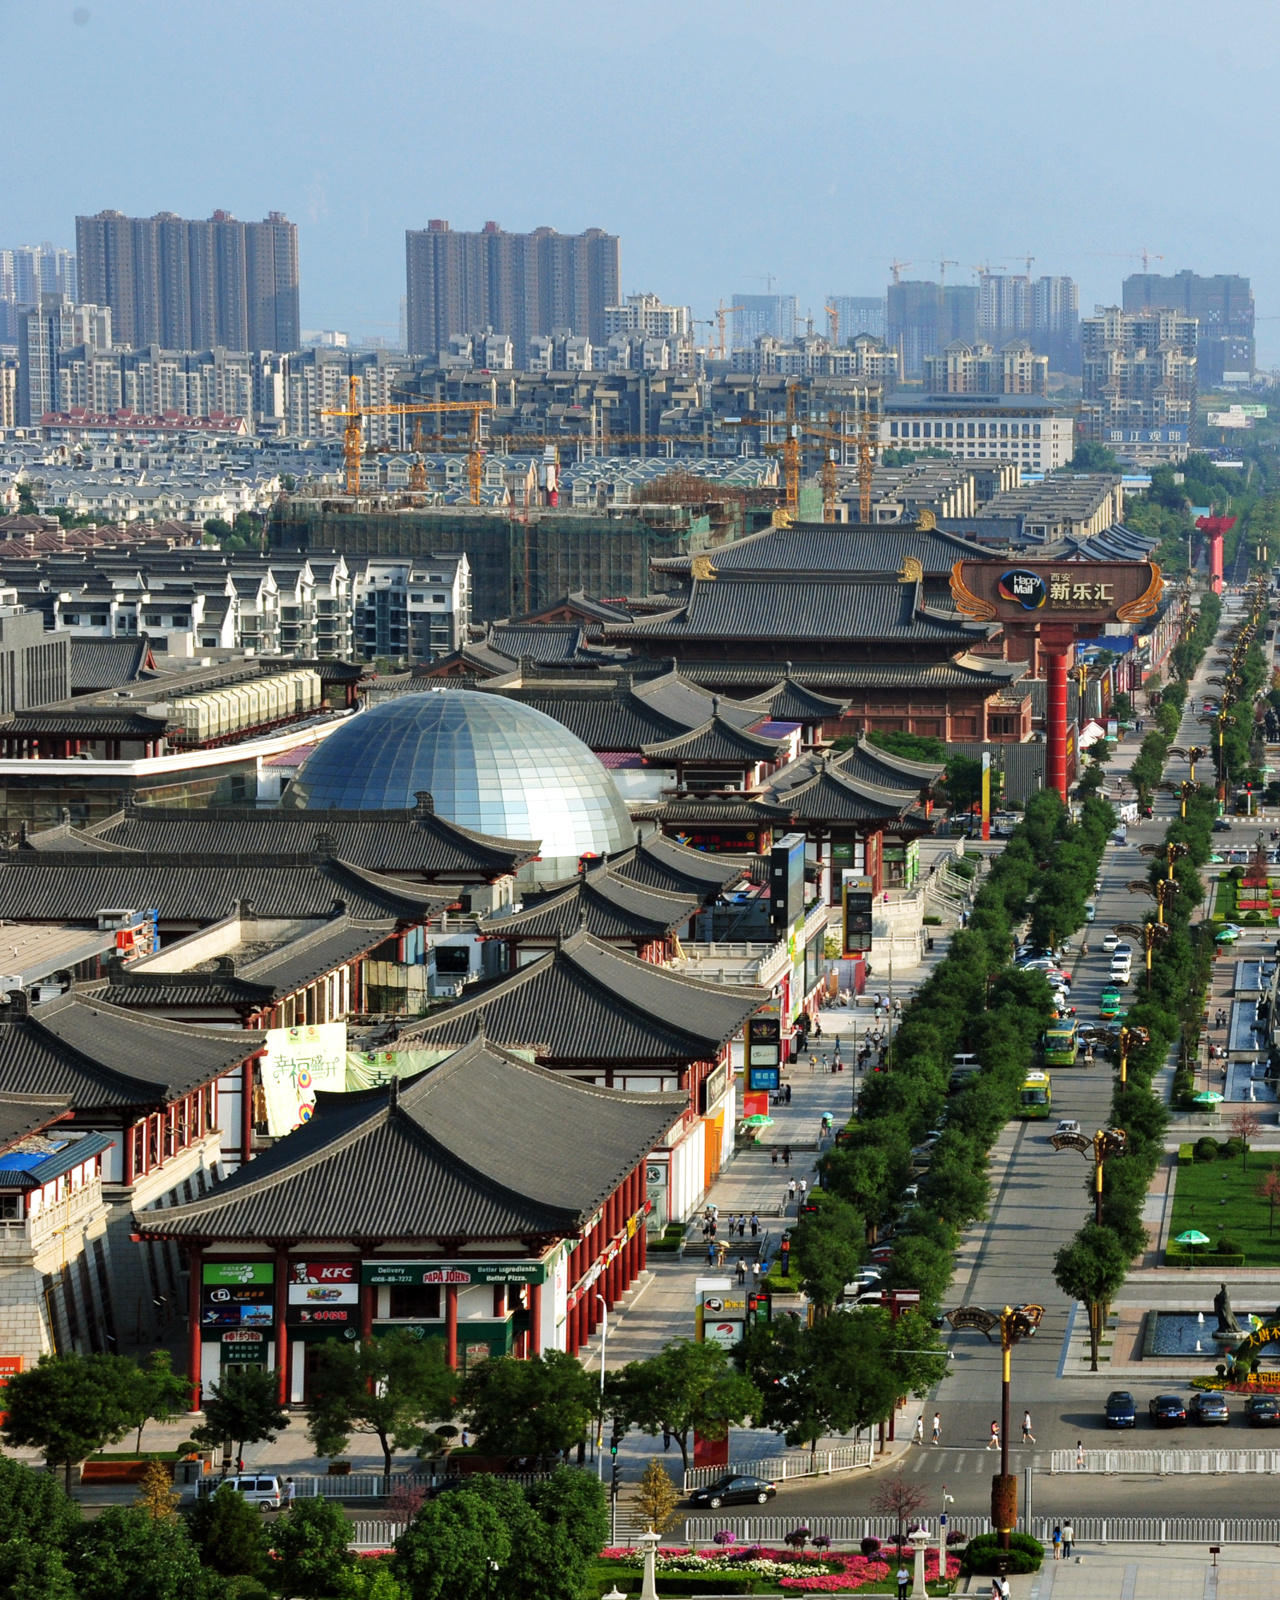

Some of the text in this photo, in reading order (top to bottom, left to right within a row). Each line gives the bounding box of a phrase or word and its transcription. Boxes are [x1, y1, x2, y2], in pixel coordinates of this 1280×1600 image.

[1013, 575, 1042, 587] Happy
[1050, 573, 1071, 582] 西安
[1013, 584, 1034, 595] Mall
[1050, 582, 1114, 600] 新乐汇
[320, 1267, 353, 1278] KFC
[423, 1271, 443, 1283] PAPA
